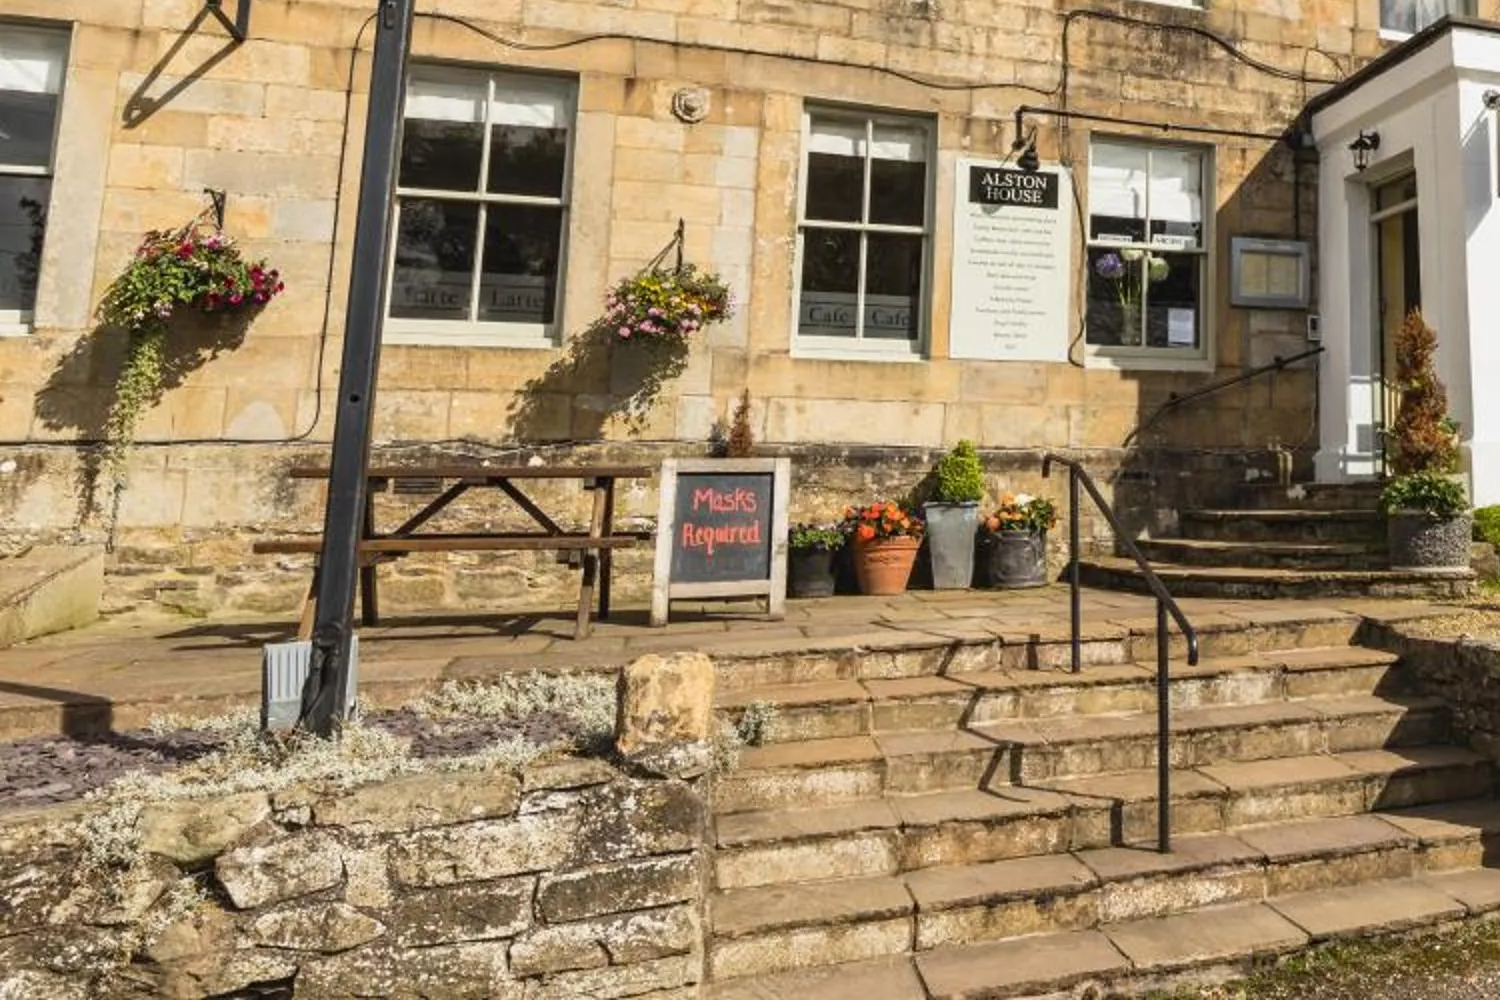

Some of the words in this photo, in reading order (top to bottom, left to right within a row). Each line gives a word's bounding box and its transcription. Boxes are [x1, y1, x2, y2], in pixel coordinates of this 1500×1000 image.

[981, 172, 1048, 190] ALSTON
[986, 186, 1043, 203] HOUSE
[682, 520, 761, 556] Required
